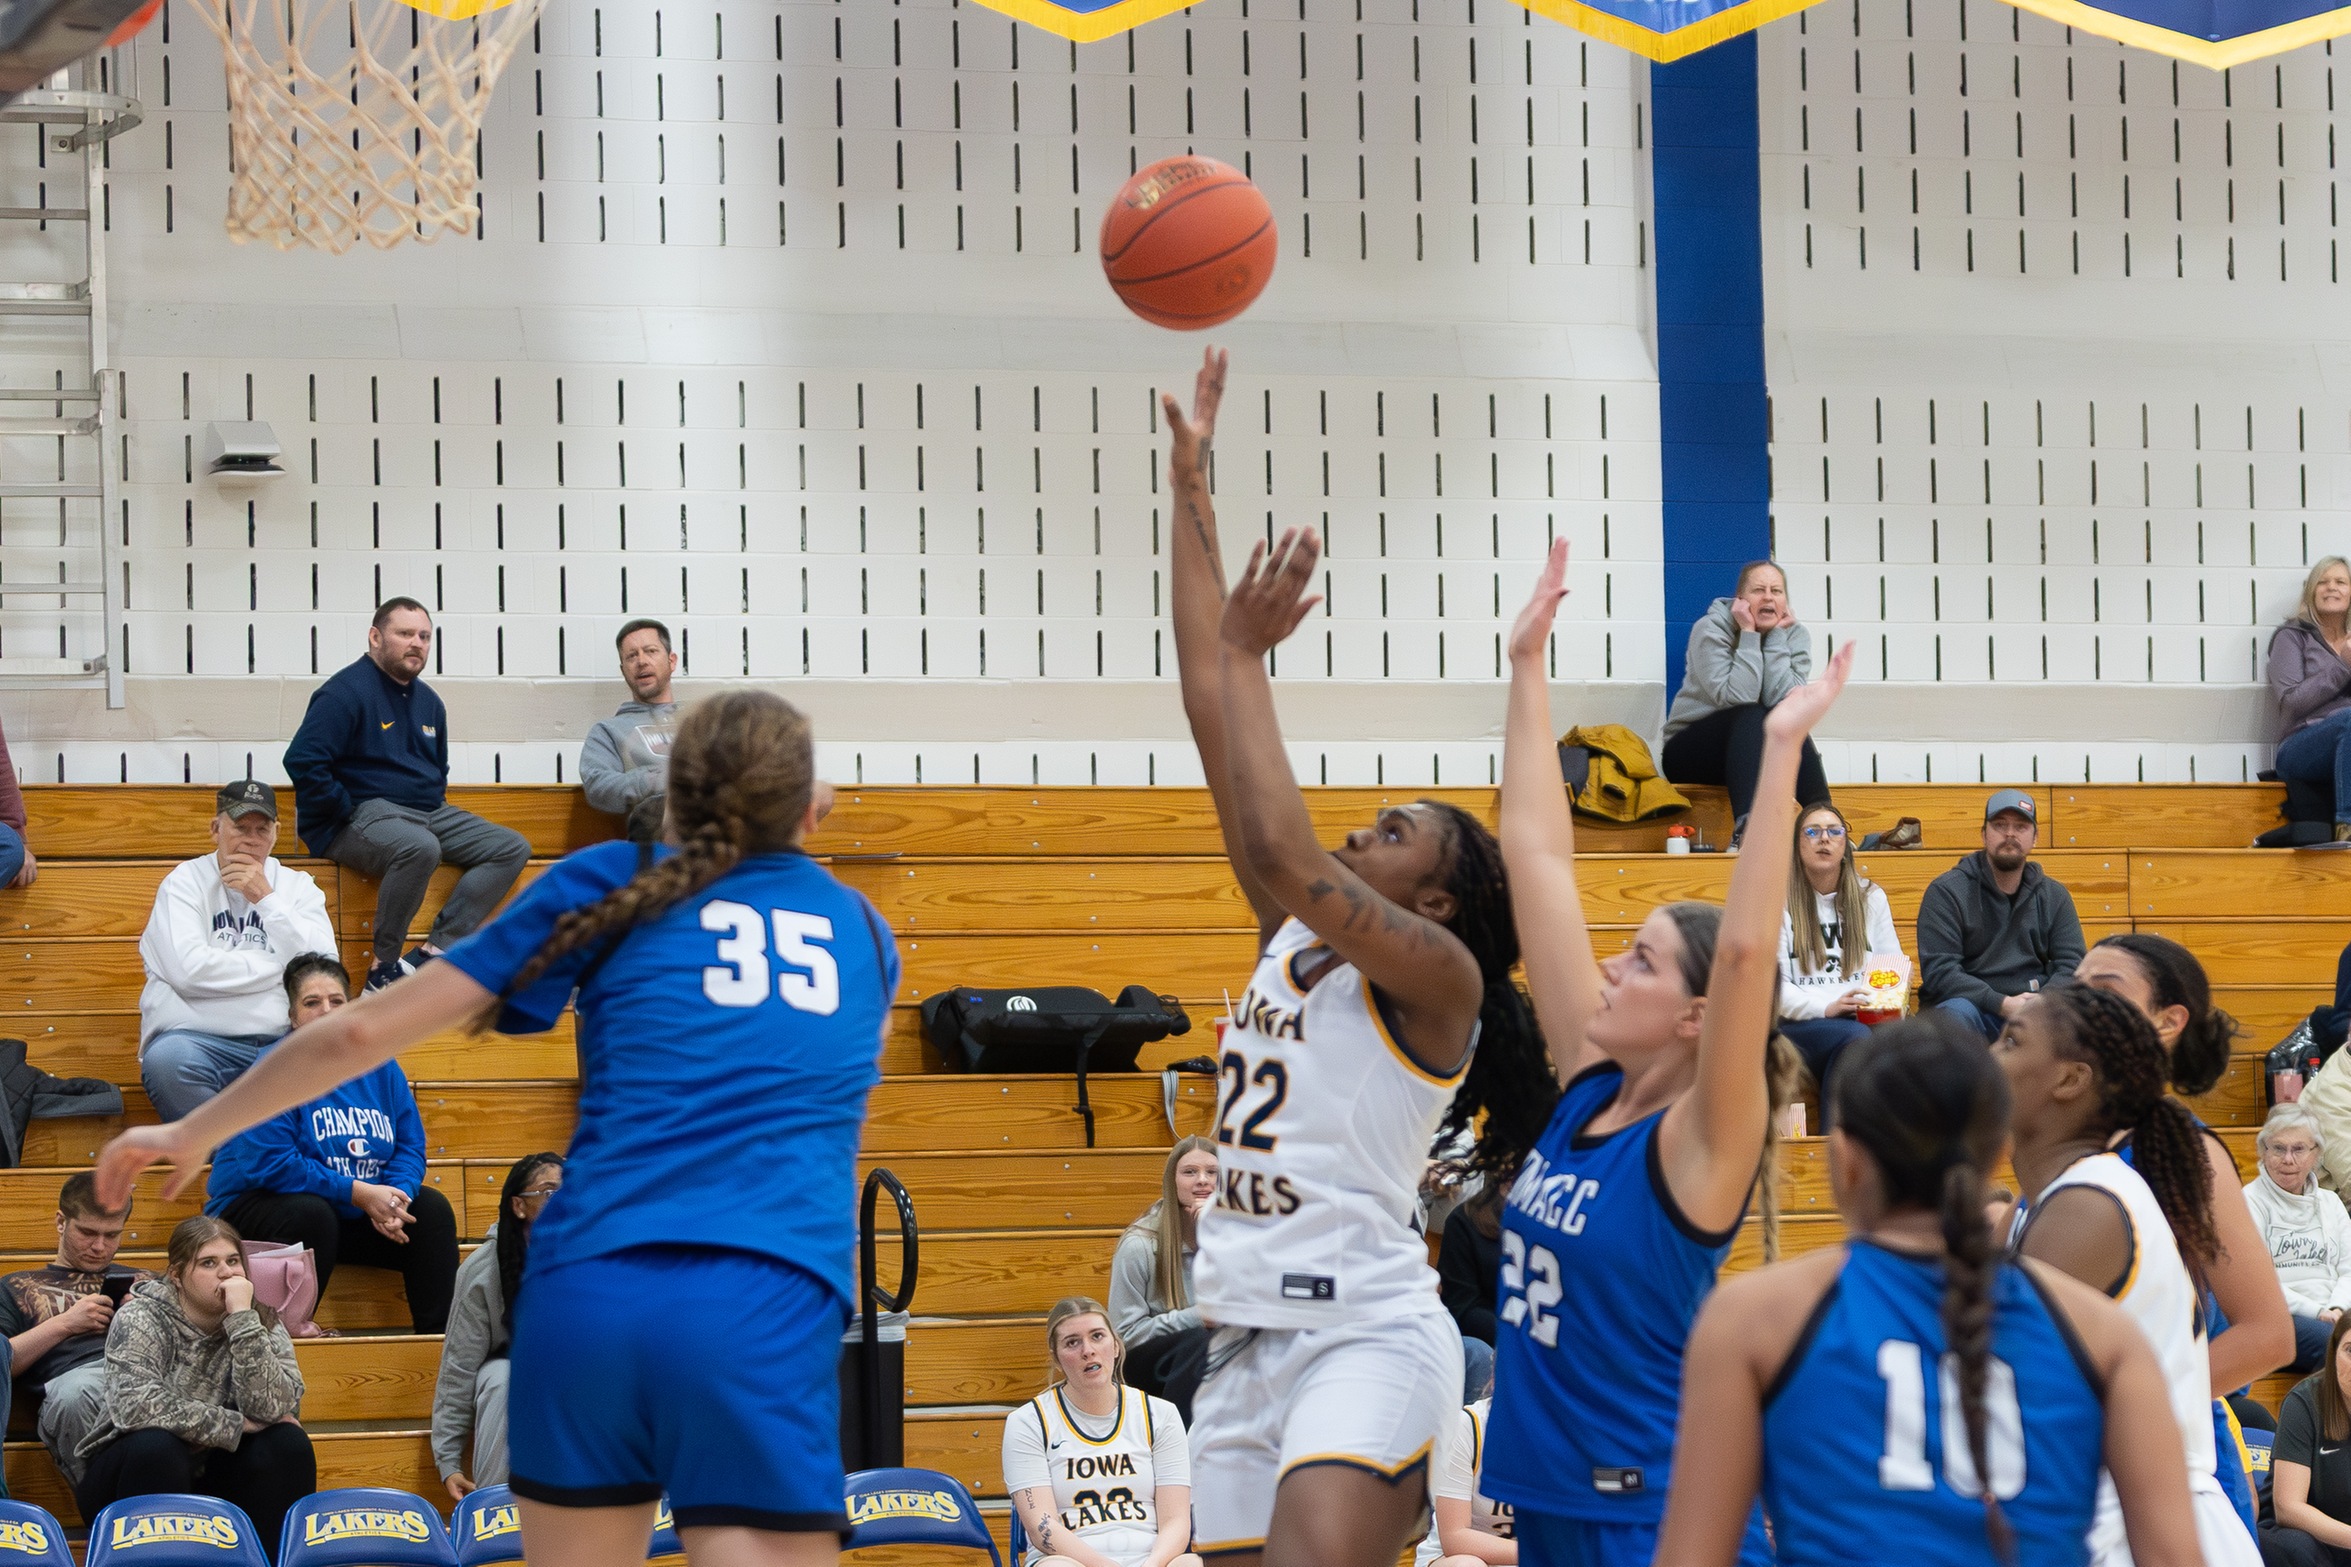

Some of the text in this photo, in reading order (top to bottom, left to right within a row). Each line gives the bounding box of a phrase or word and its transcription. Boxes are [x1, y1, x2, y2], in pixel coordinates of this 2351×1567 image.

[217, 931, 267, 945] ATTICS
[699, 899, 840, 1017] 35
[1799, 971, 1866, 986] HAWKEE
[1219, 1049, 1290, 1154] 22
[312, 1106, 395, 1145] CHAMPION
[1216, 1167, 1301, 1216] KES
[1500, 1228, 1564, 1349] 22
[1876, 1338, 2028, 1501] 10
[1066, 1452, 1138, 1481] IOWA
[843, 1490, 961, 1522] LAKERS
[1061, 1500, 1148, 1531] LAKES
[110, 1515, 239, 1545] LAKERS
[304, 1510, 430, 1543] LAKERS
